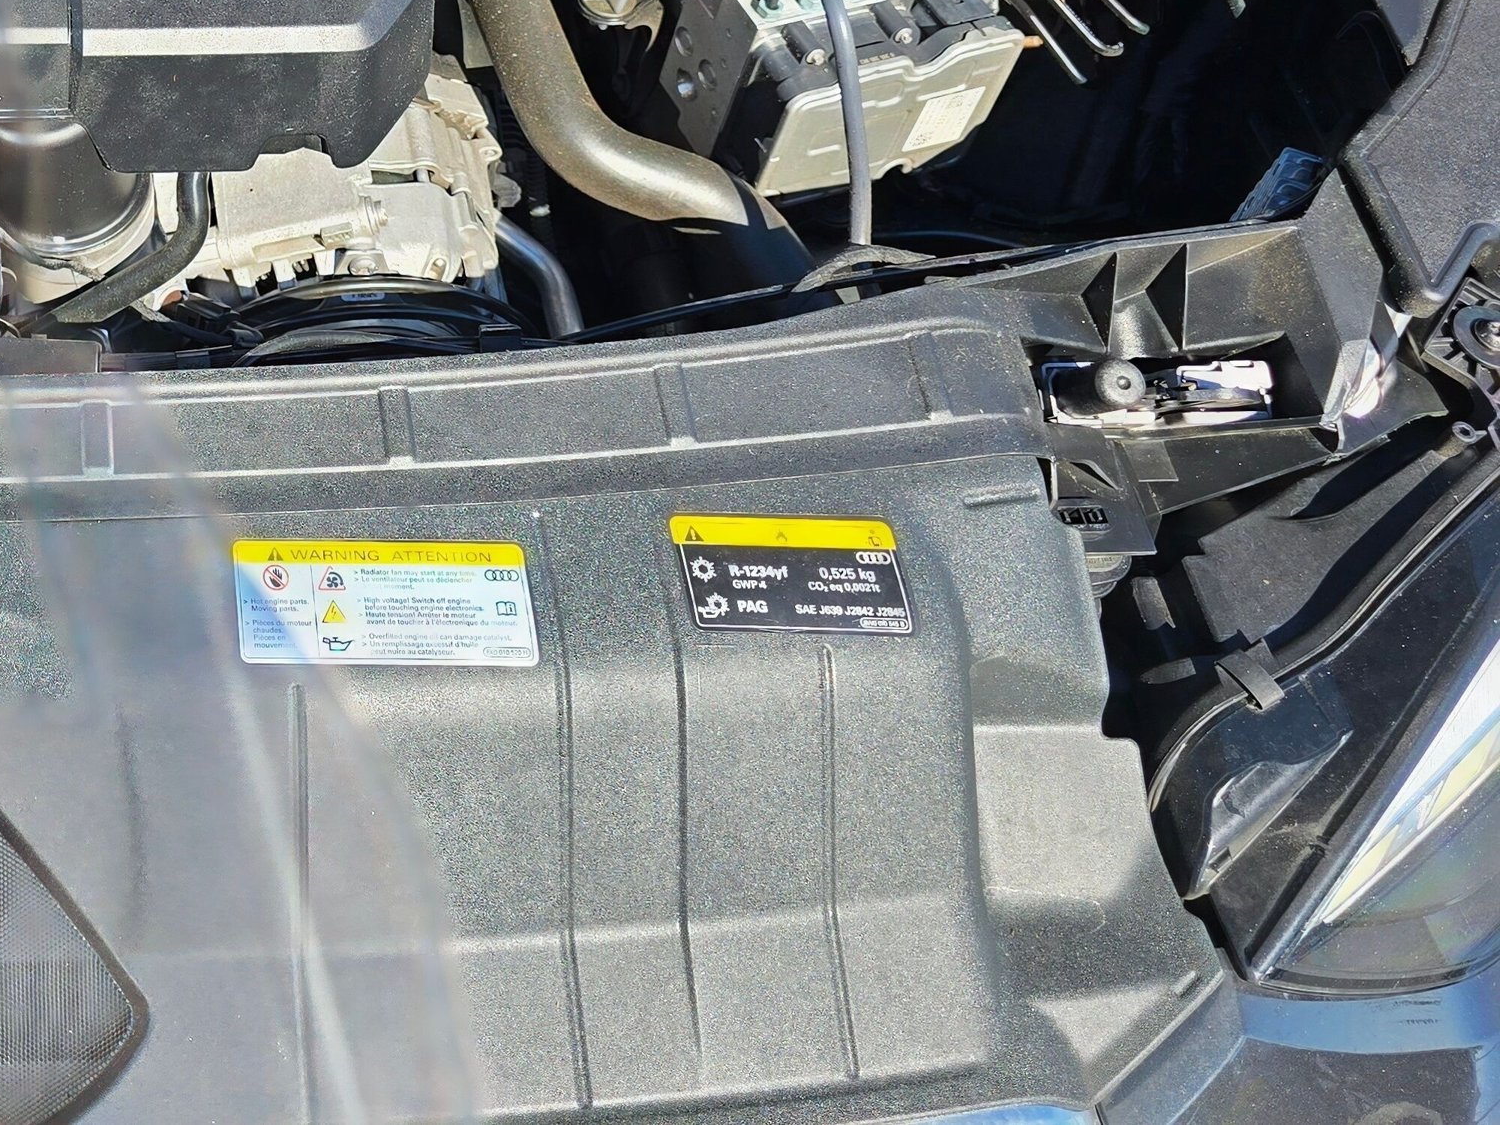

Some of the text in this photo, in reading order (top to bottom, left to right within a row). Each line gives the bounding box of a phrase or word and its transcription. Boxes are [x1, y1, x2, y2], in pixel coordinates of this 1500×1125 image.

[290, 549, 492, 562] WARNING ATTENTION
[404, 569, 418, 577] may
[728, 565, 788, 580] R-1234yf
[819, 567, 876, 583] 0,525 kg
[732, 579, 758, 589] GWP
[829, 584, 843, 593] eq
[364, 597, 380, 605] High
[737, 600, 768, 613] PAG
[795, 604, 817, 614] SAE
[819, 605, 843, 615] J639
